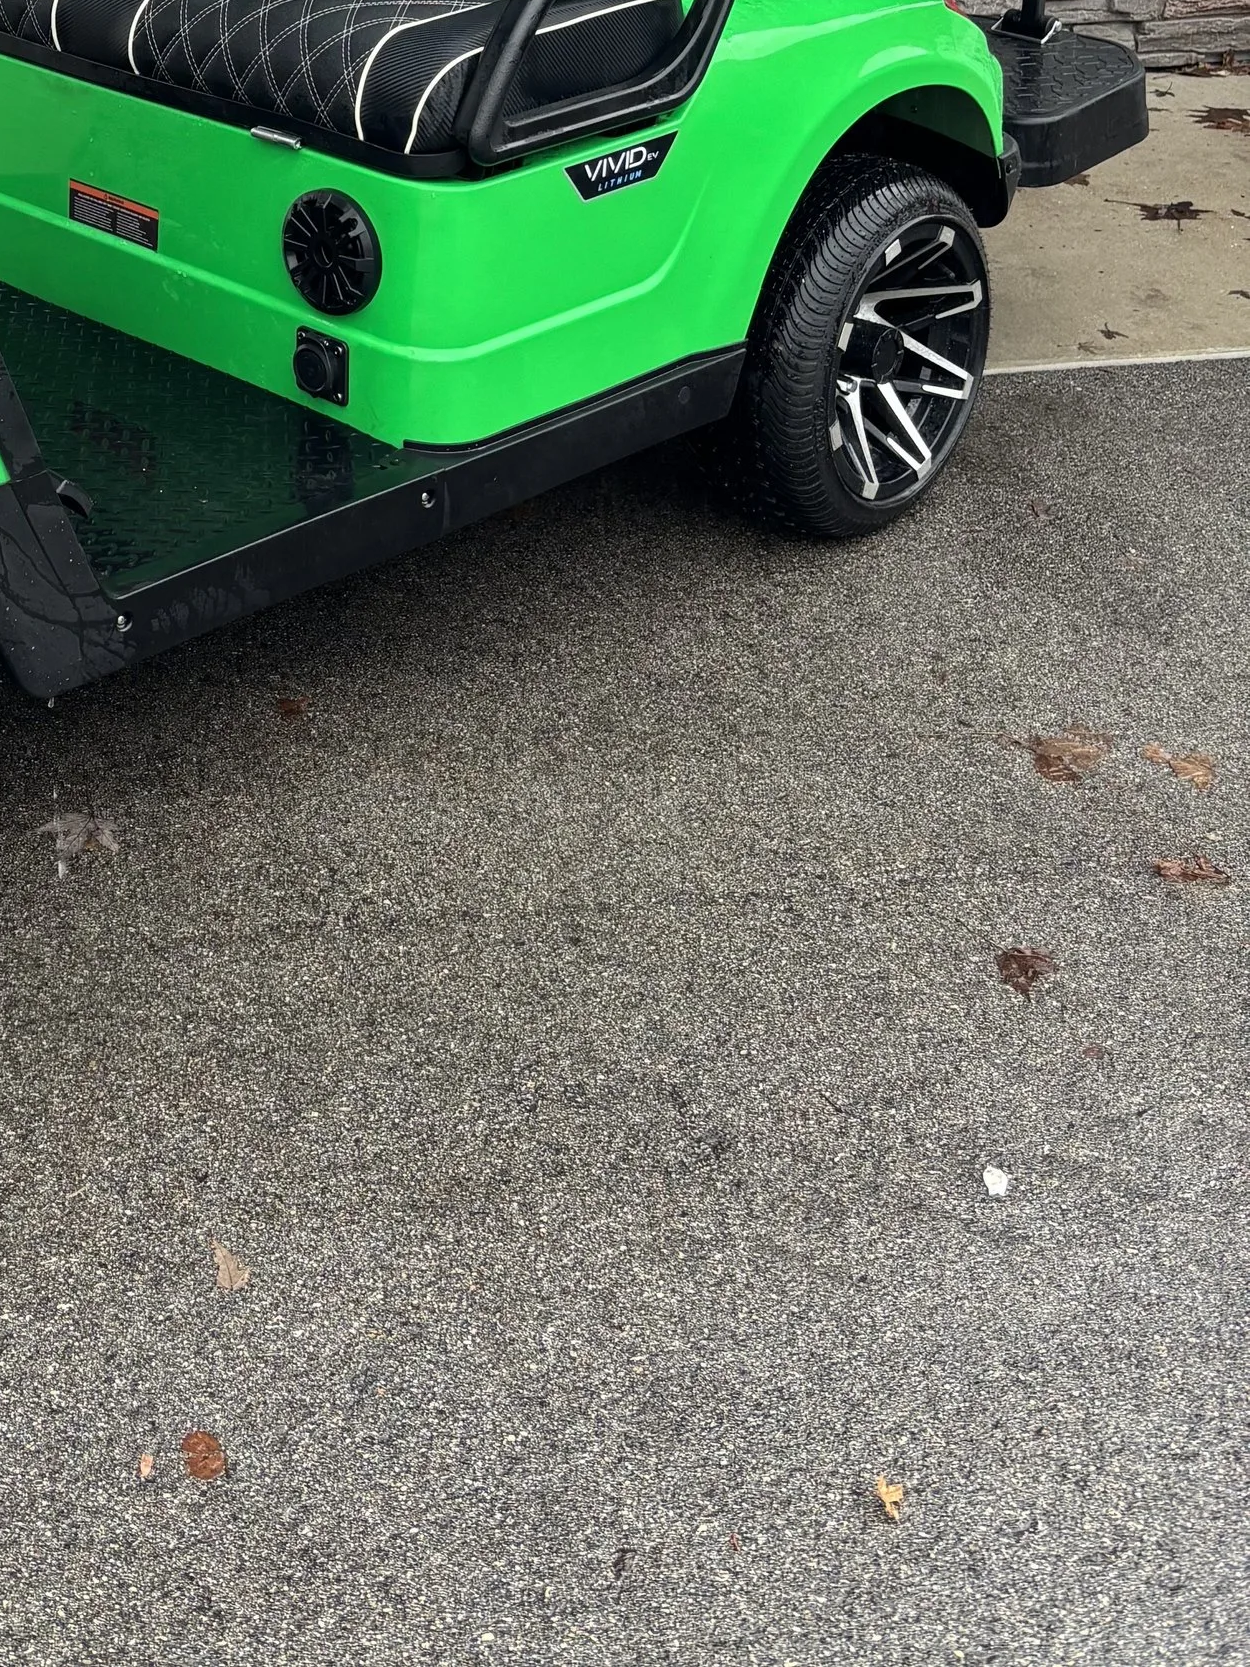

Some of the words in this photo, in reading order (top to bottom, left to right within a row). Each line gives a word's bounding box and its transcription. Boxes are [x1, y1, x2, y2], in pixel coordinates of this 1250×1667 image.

[584, 146, 647, 182] VIVID
[646, 150, 660, 161] EV
[597, 169, 642, 192] LITHIUM
